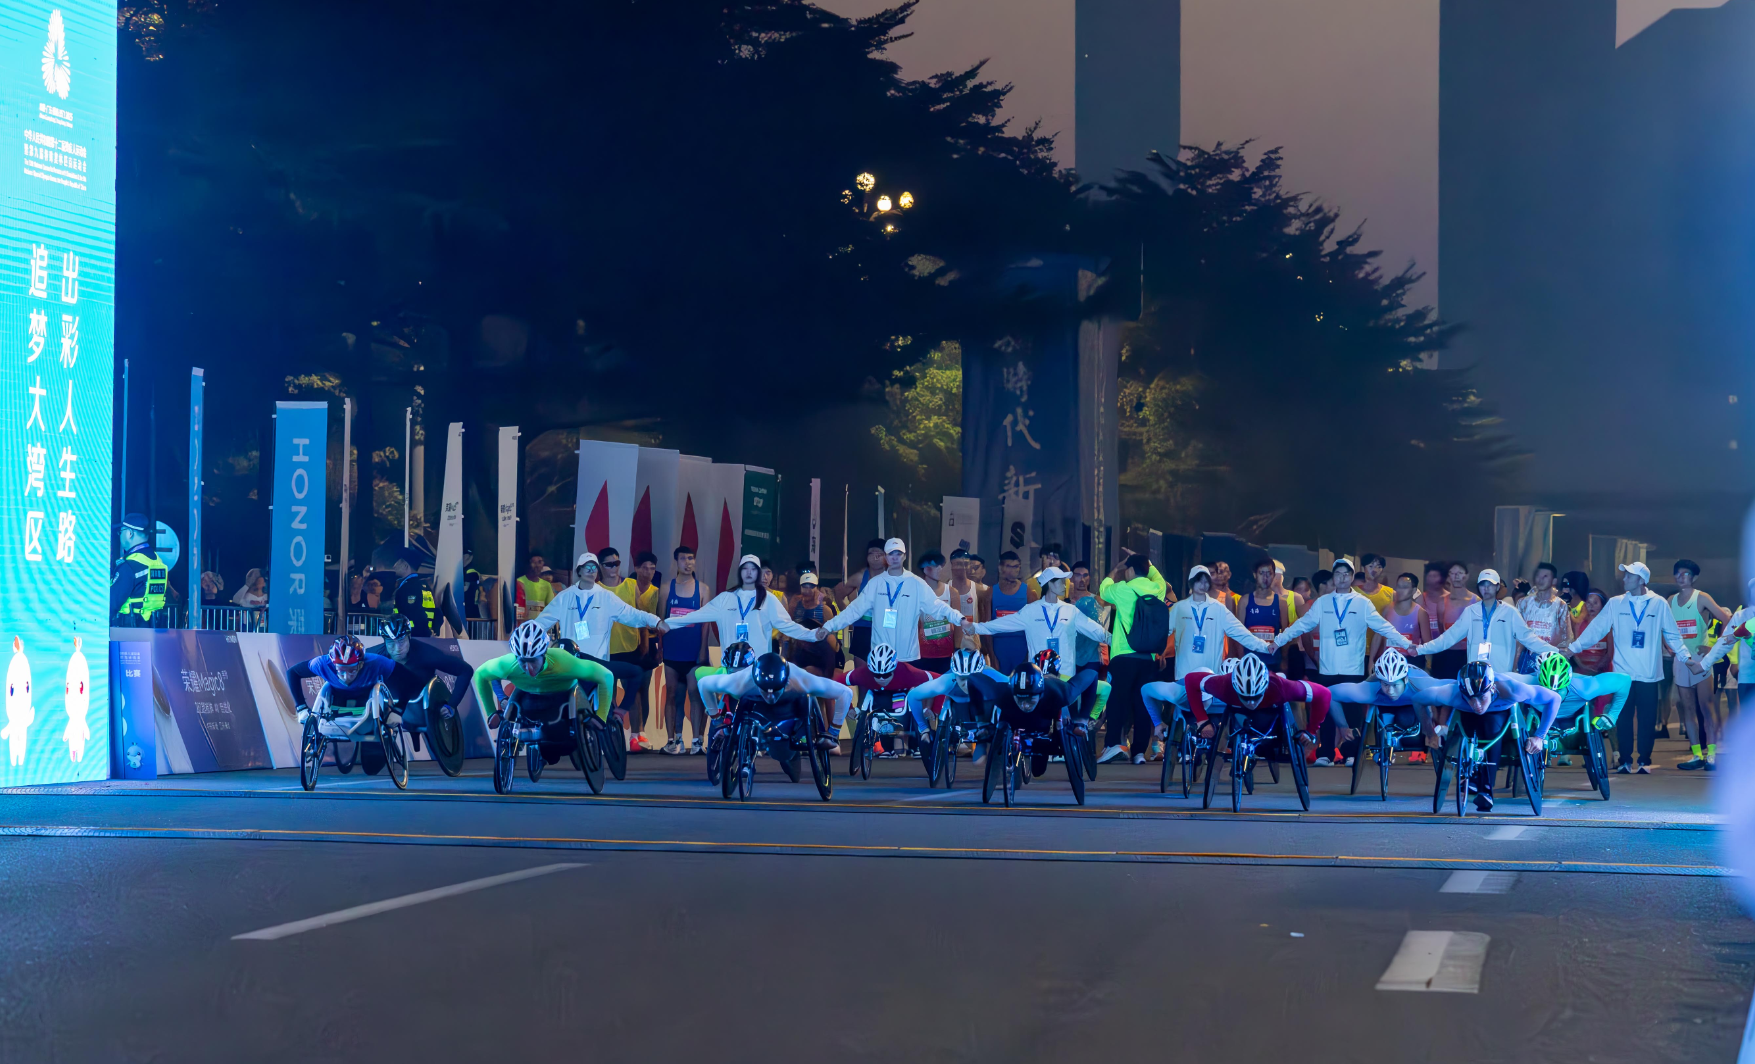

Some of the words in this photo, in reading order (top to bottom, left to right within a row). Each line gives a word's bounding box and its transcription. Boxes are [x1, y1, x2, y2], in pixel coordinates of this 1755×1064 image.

[24, 243, 48, 562] 追梦大湾区
[56, 251, 79, 563] 出彩人生路
[289, 438, 310, 595] HONOR
[125, 669, 141, 678] 比赛
